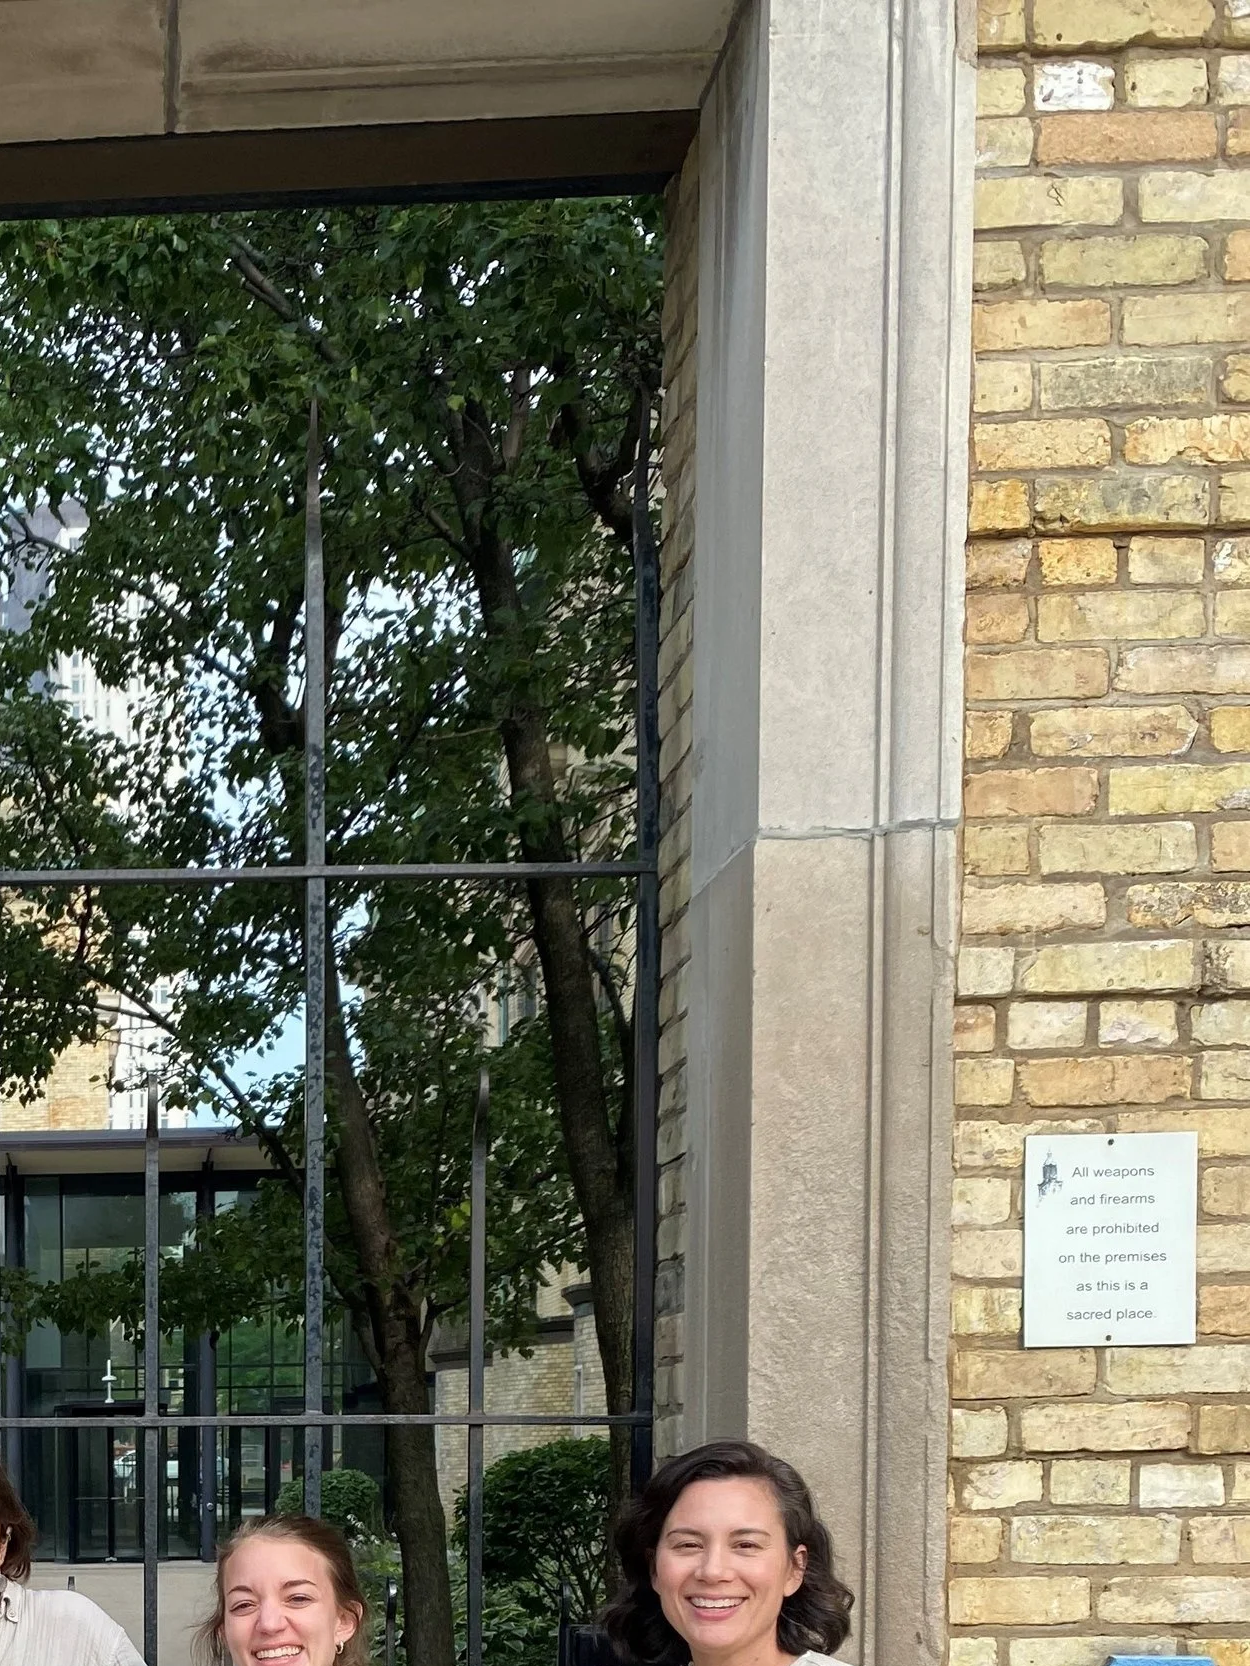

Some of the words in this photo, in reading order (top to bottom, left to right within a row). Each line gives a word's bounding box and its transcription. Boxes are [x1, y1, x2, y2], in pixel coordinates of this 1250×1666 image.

[1071, 1166, 1089, 1178] All
[1093, 1166, 1155, 1179] weapons
[1070, 1194, 1096, 1206] and
[1099, 1193, 1156, 1205] firearms
[1066, 1224, 1088, 1235] are
[1092, 1222, 1160, 1237] prohibited
[1058, 1253, 1076, 1264] on
[1079, 1251, 1101, 1263] the
[1105, 1251, 1167, 1265] premises
[1076, 1282, 1093, 1292] as
[1096, 1280, 1120, 1291] this
[1124, 1279, 1136, 1291] is
[1140, 1281, 1149, 1291] a
[1066, 1308, 1112, 1320] sacred
